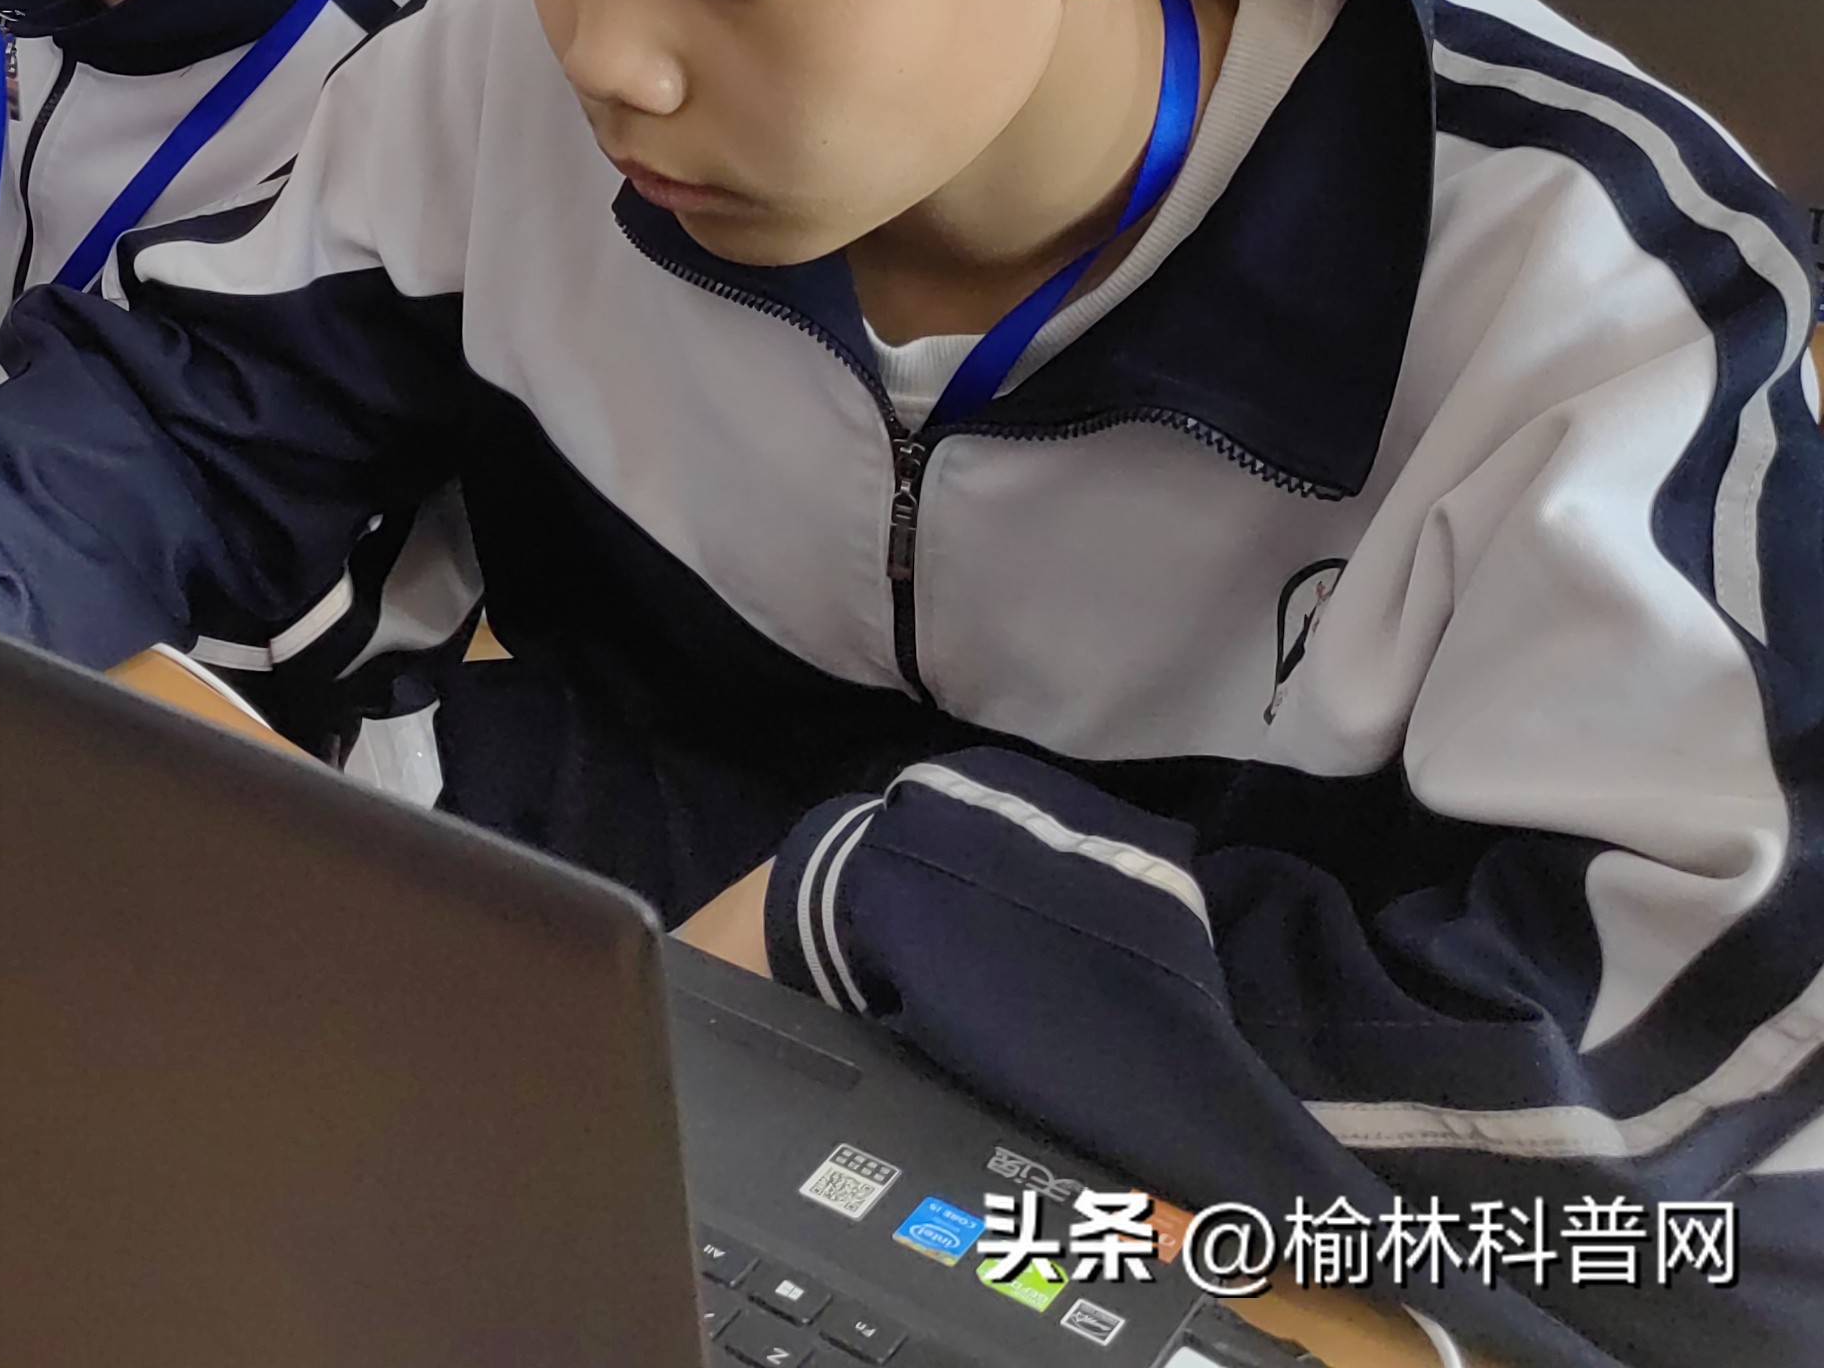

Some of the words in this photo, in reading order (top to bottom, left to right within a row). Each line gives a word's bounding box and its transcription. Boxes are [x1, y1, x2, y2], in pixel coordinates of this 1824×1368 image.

[917, 1223, 958, 1249] intel
[854, 1320, 877, 1338] Fn
[766, 1347, 791, 1365] Z
